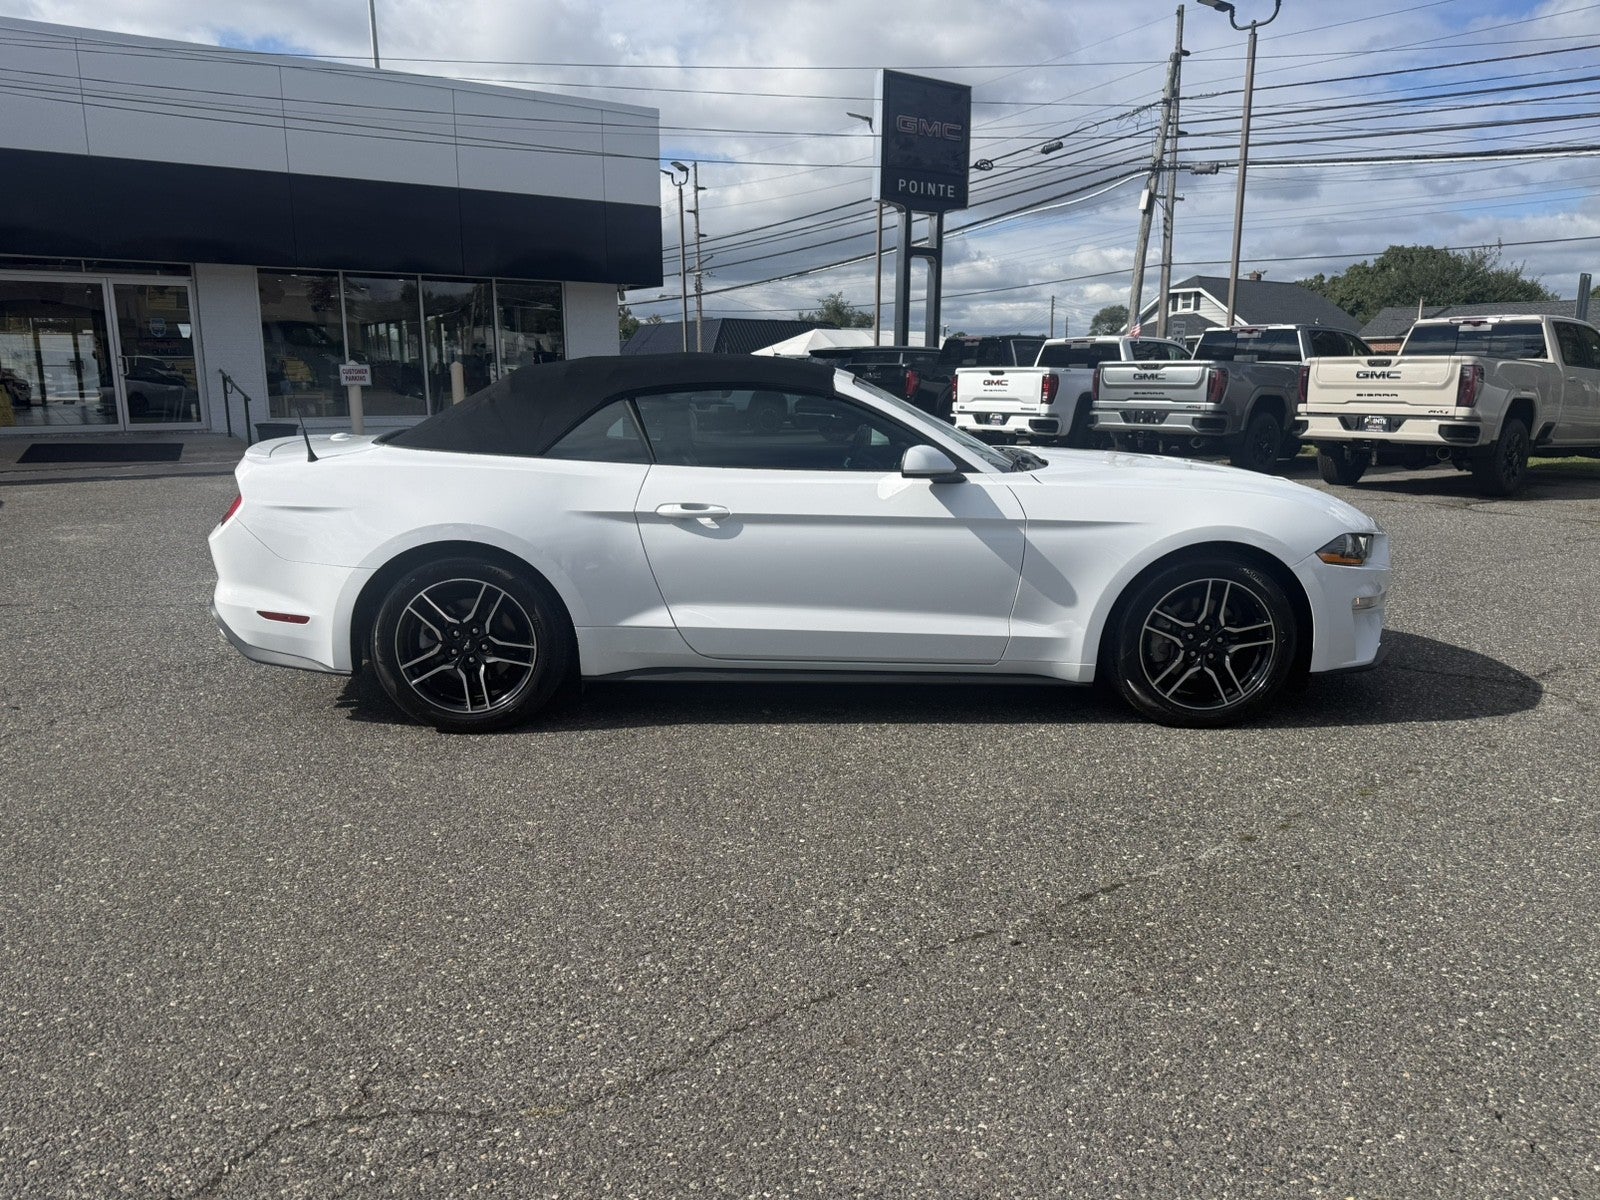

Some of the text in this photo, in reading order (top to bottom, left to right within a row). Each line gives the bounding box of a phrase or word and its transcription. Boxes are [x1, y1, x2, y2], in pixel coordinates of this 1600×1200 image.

[896, 114, 961, 141] GMC
[898, 178, 955, 198] POINTE
[1133, 372, 1166, 380] GMC
[1355, 370, 1402, 379] GMC
